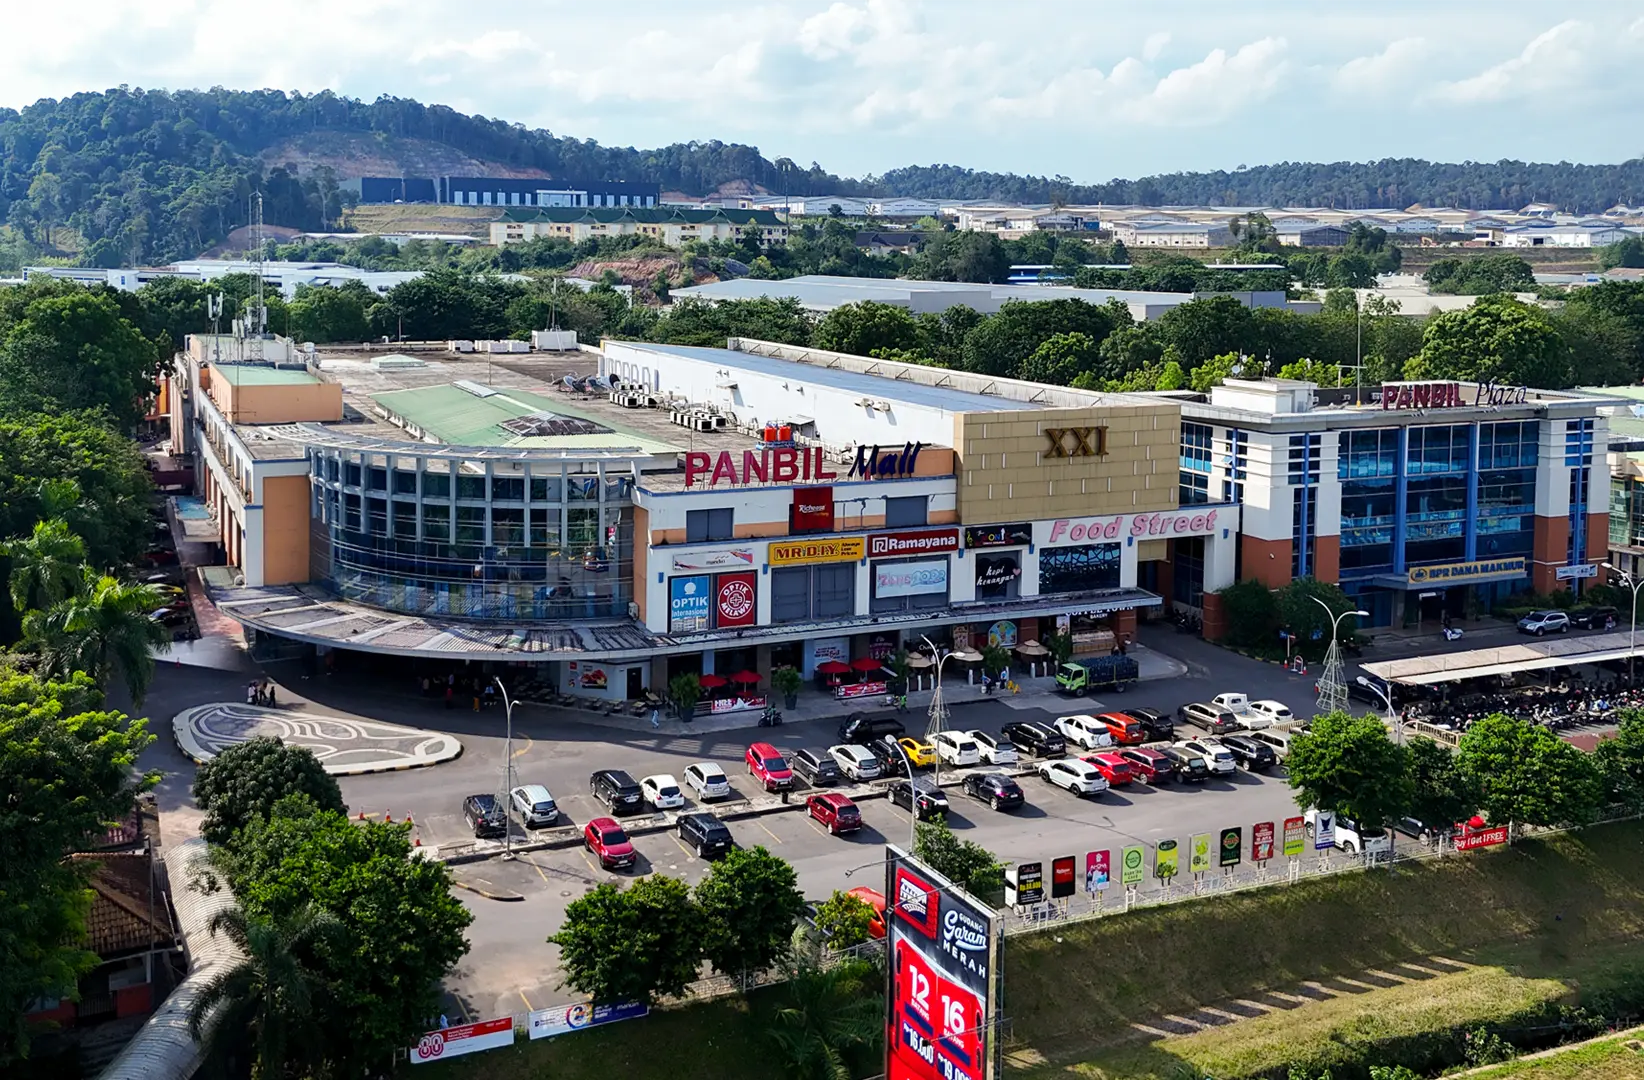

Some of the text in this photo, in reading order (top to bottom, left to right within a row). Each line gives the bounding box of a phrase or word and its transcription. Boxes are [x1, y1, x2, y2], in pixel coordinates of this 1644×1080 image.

[1382, 381, 1528, 410] PANBIL Plaza
[1044, 425, 1109, 458] XXI
[685, 440, 921, 487] PANBIL Mall
[1049, 509, 1218, 543] Food Street
[889, 536, 956, 550] Ramayana
[986, 566, 1004, 576] kopi
[1451, 565, 1479, 577] DANA
[1480, 560, 1524, 573] MAKMUR
[723, 584, 749, 595] OPTIK
[976, 575, 1015, 586] kenangan
[672, 596, 708, 608] OPTIK
[721, 600, 752, 616] MELAWAI
[1487, 831, 1504, 841] FREE
[944, 910, 986, 947] Garam
[959, 912, 984, 933] GUDANG
[943, 939, 986, 978] MERAH
[909, 964, 929, 1011] 12
[941, 995, 964, 1034] 16
[418, 1033, 444, 1058] 80
